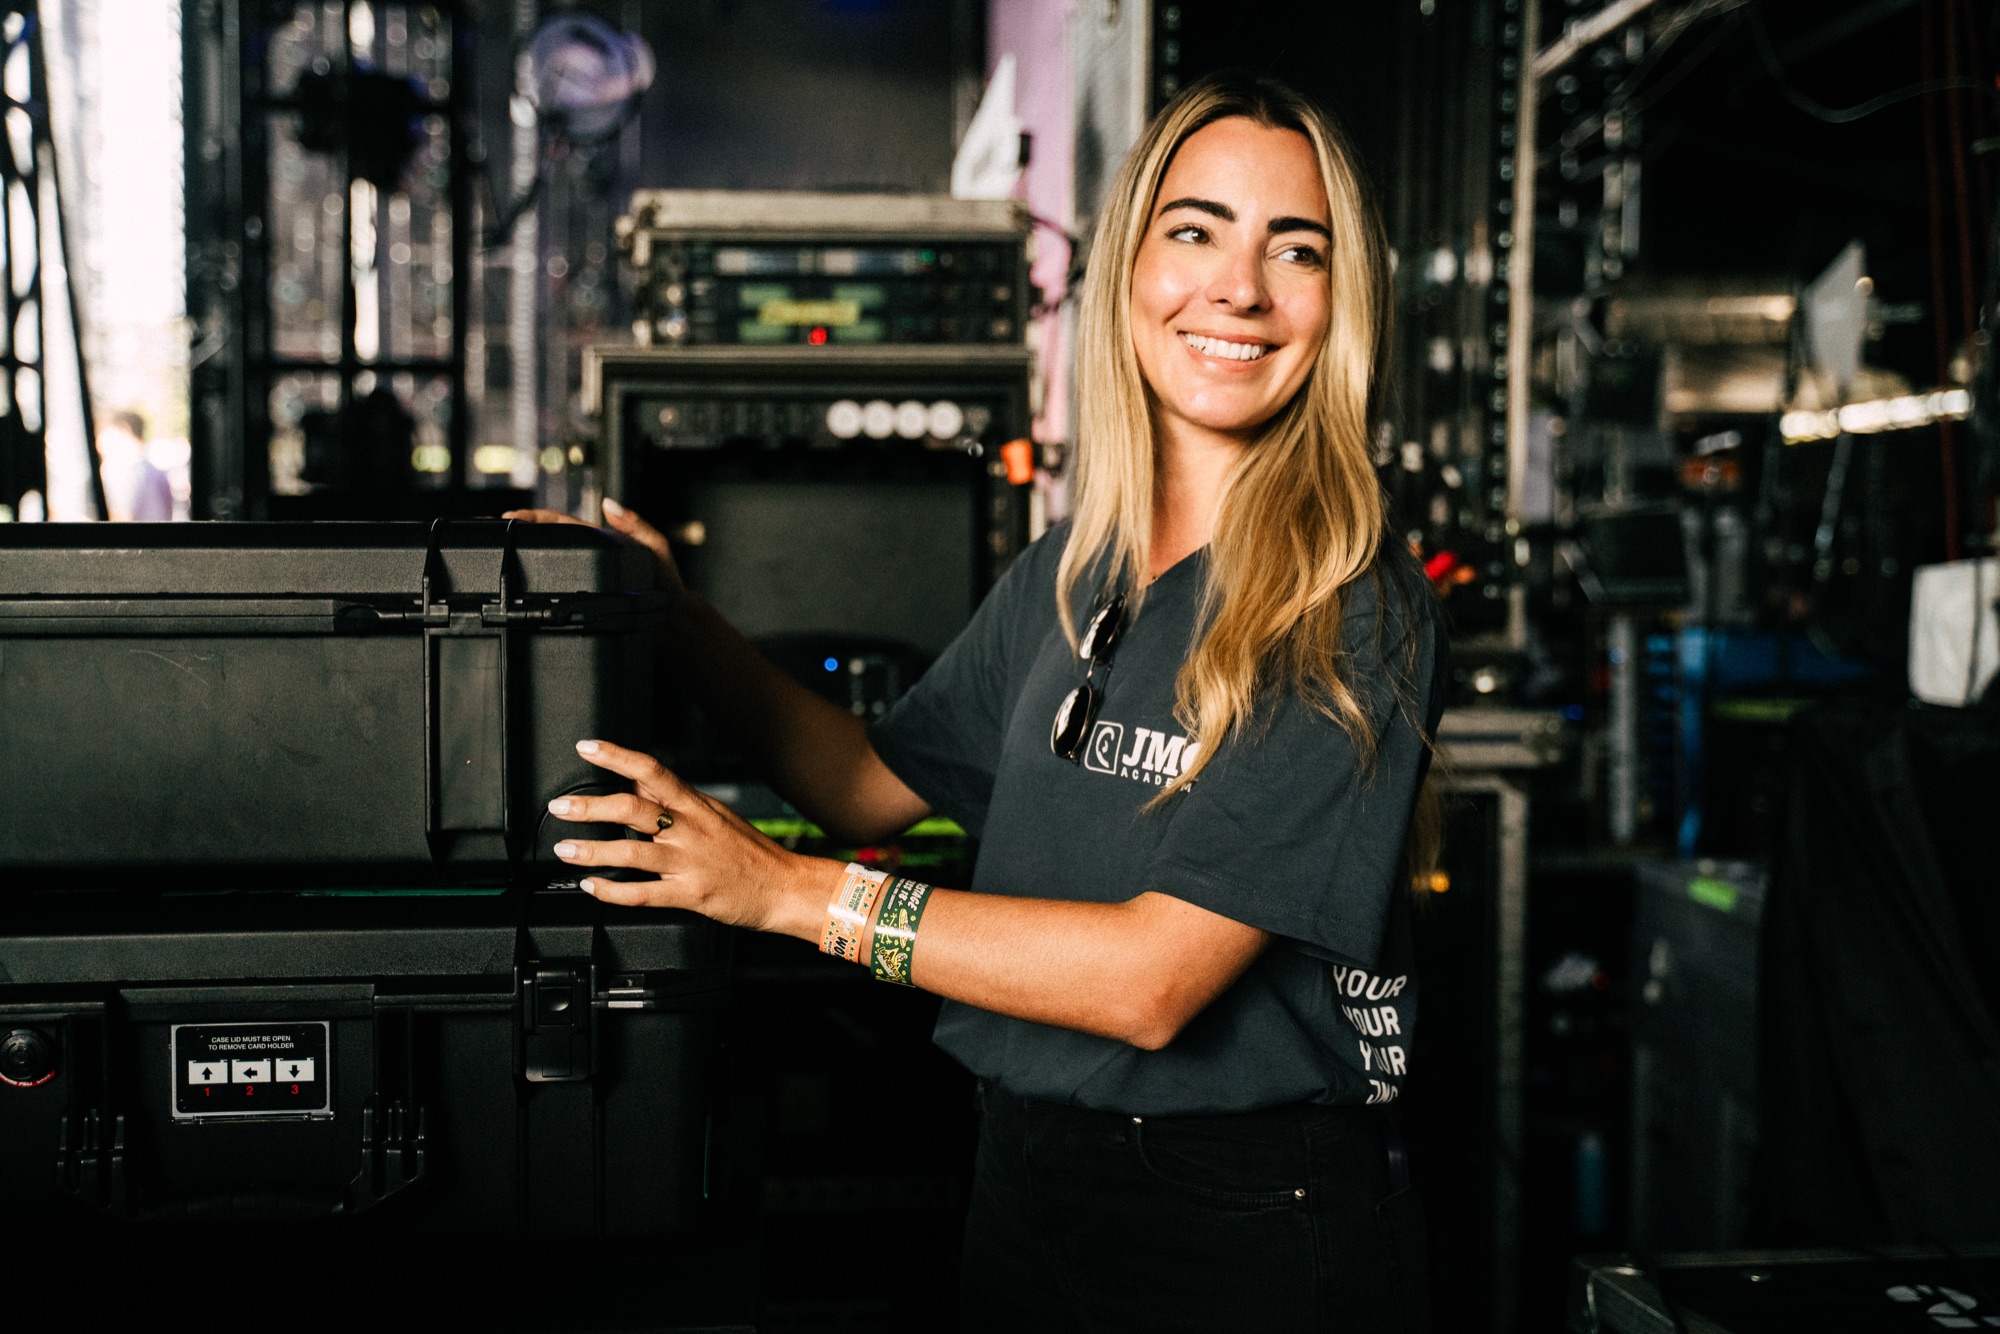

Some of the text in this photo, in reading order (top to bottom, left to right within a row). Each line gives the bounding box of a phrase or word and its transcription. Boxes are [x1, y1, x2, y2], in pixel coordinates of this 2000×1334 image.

[1120, 766, 1194, 793] ACADEM
[1333, 965, 1408, 1001] YOUR
[1341, 1004, 1402, 1037] YOUR
[1359, 1040, 1407, 1076] YUR
[204, 1084, 299, 1097] 1 2 3
